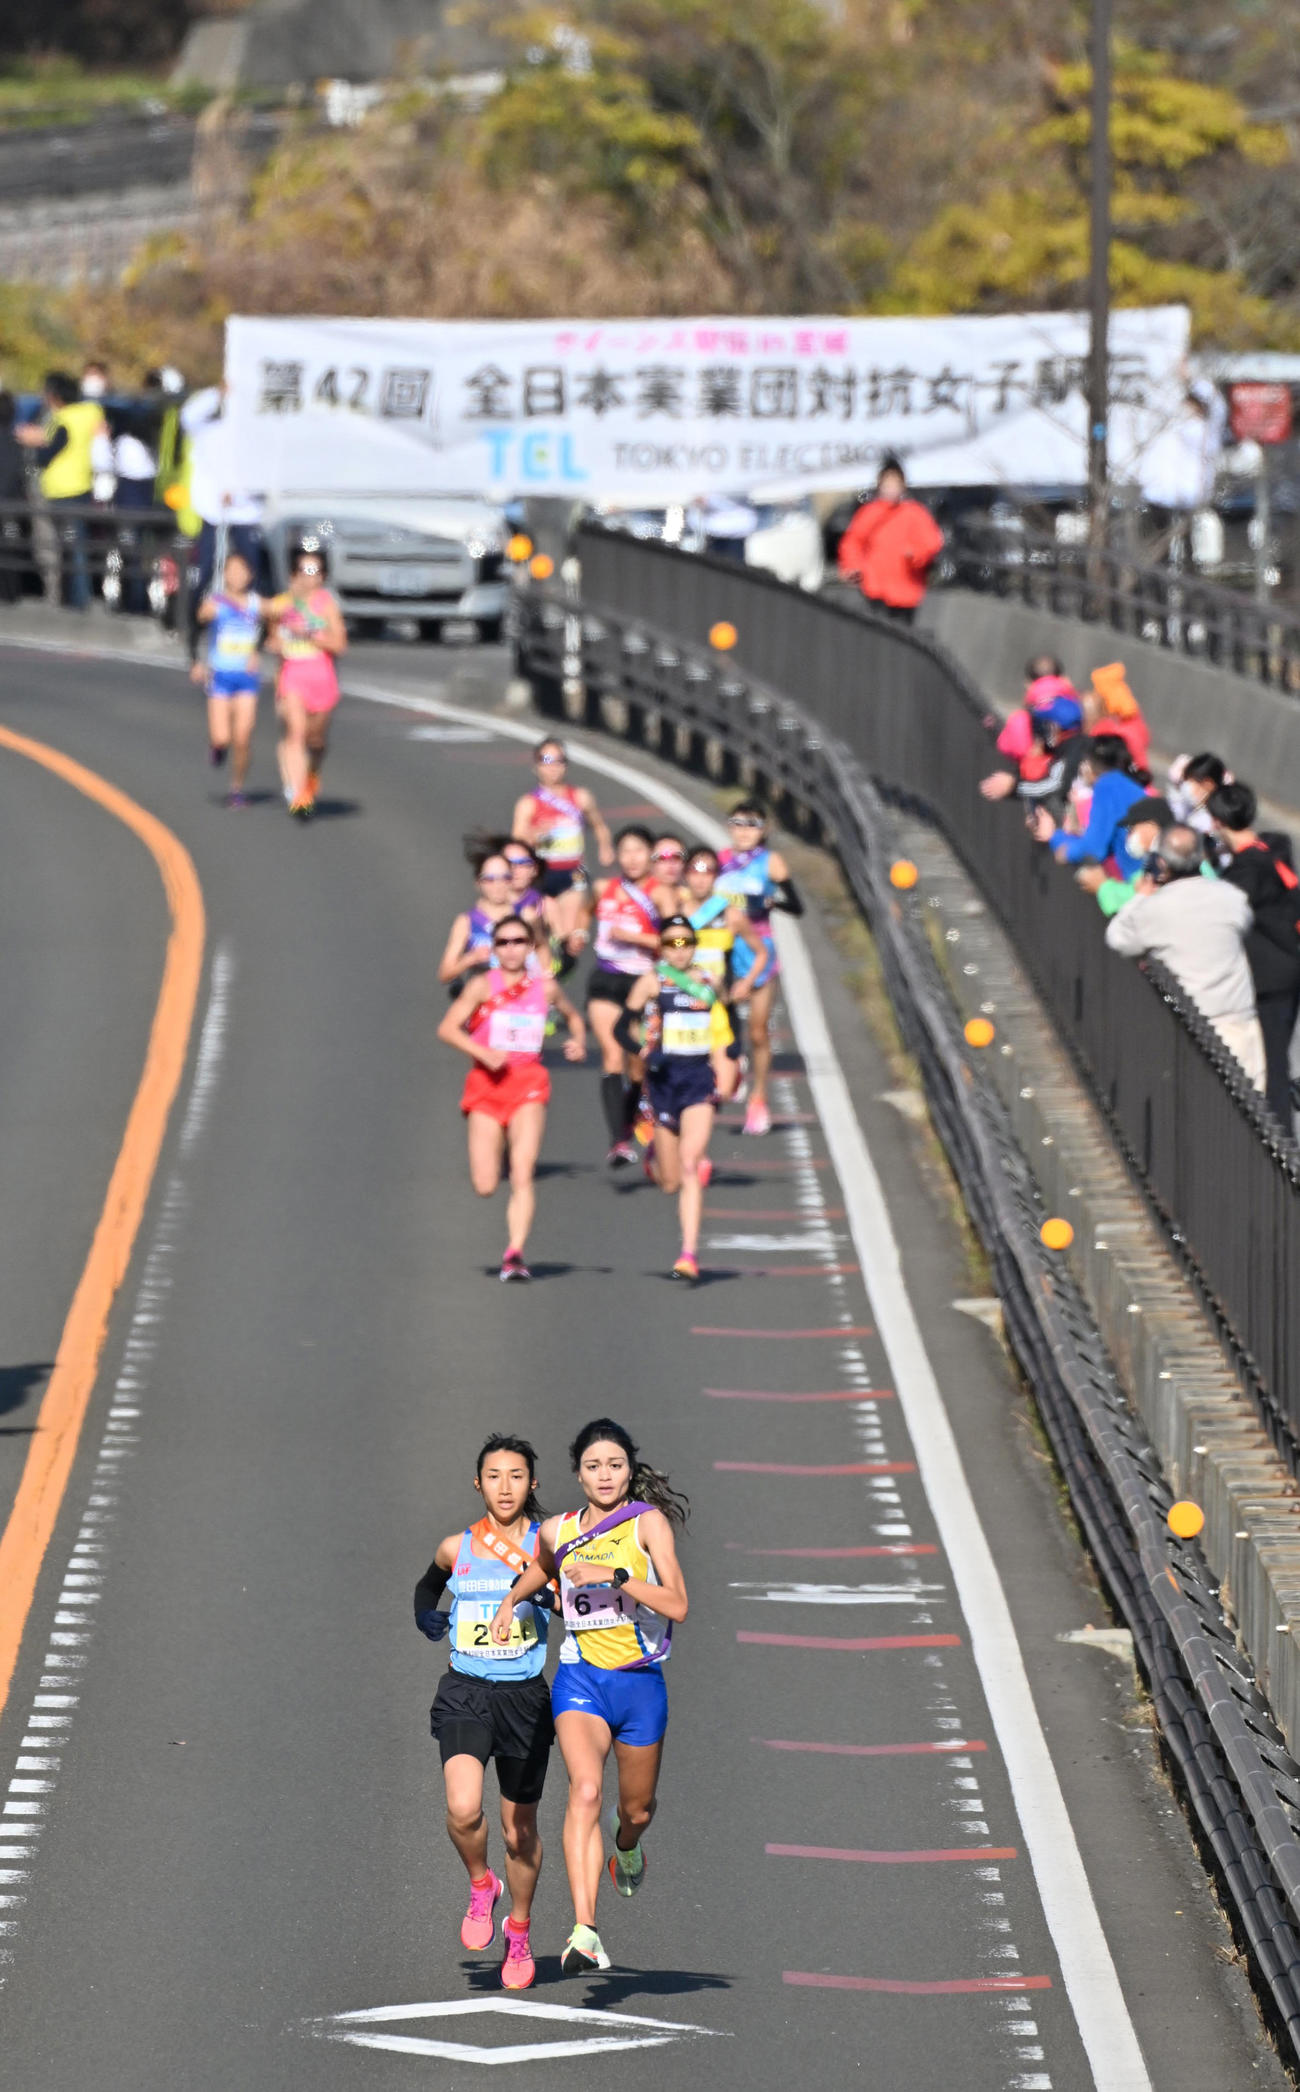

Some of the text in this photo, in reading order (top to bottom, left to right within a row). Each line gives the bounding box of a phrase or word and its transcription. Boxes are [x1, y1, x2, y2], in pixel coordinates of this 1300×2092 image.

[261, 358, 431, 419] 第42回
[482, 429, 589, 480] TEL
[614, 440, 728, 474] TOKYO
[473, 1623, 528, 1646] 2-1
